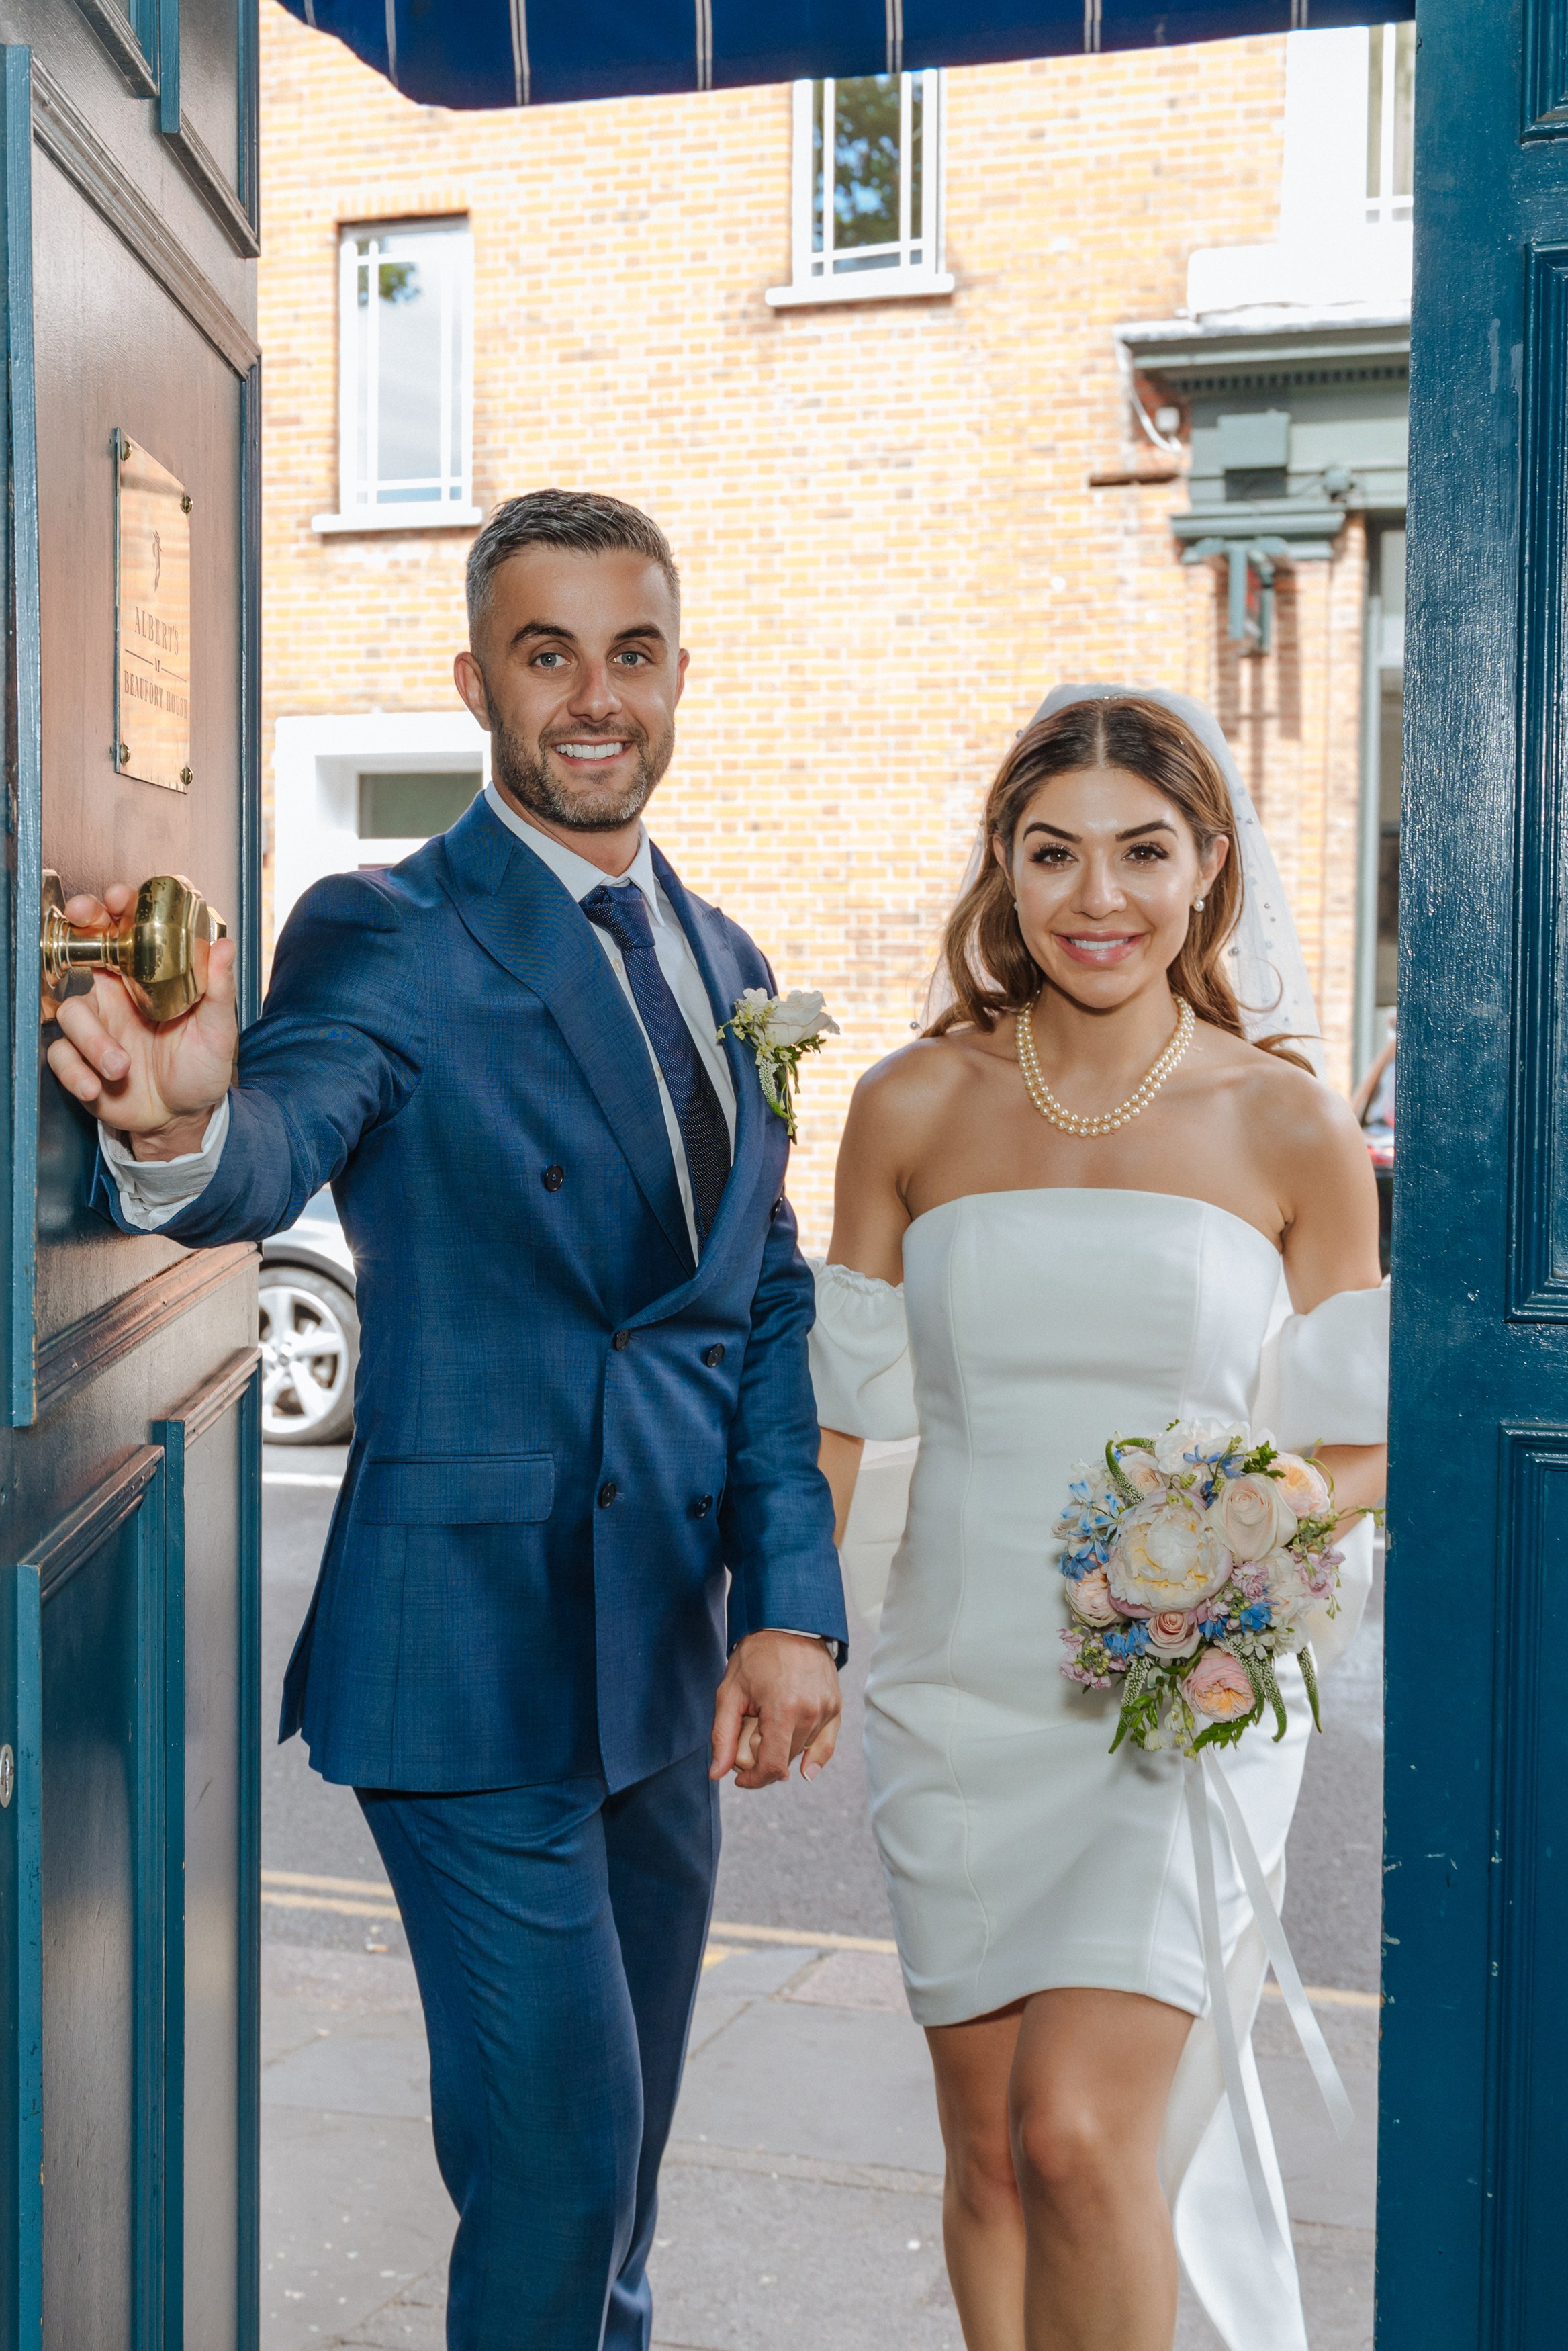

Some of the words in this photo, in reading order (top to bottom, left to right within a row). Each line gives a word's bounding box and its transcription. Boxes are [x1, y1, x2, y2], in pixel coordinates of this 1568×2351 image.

[134, 606, 179, 656] ALBERT'S
[154, 658, 160, 672] AT
[124, 670, 163, 709] BEAUFORT
[166, 690, 187, 719] HOUSE
